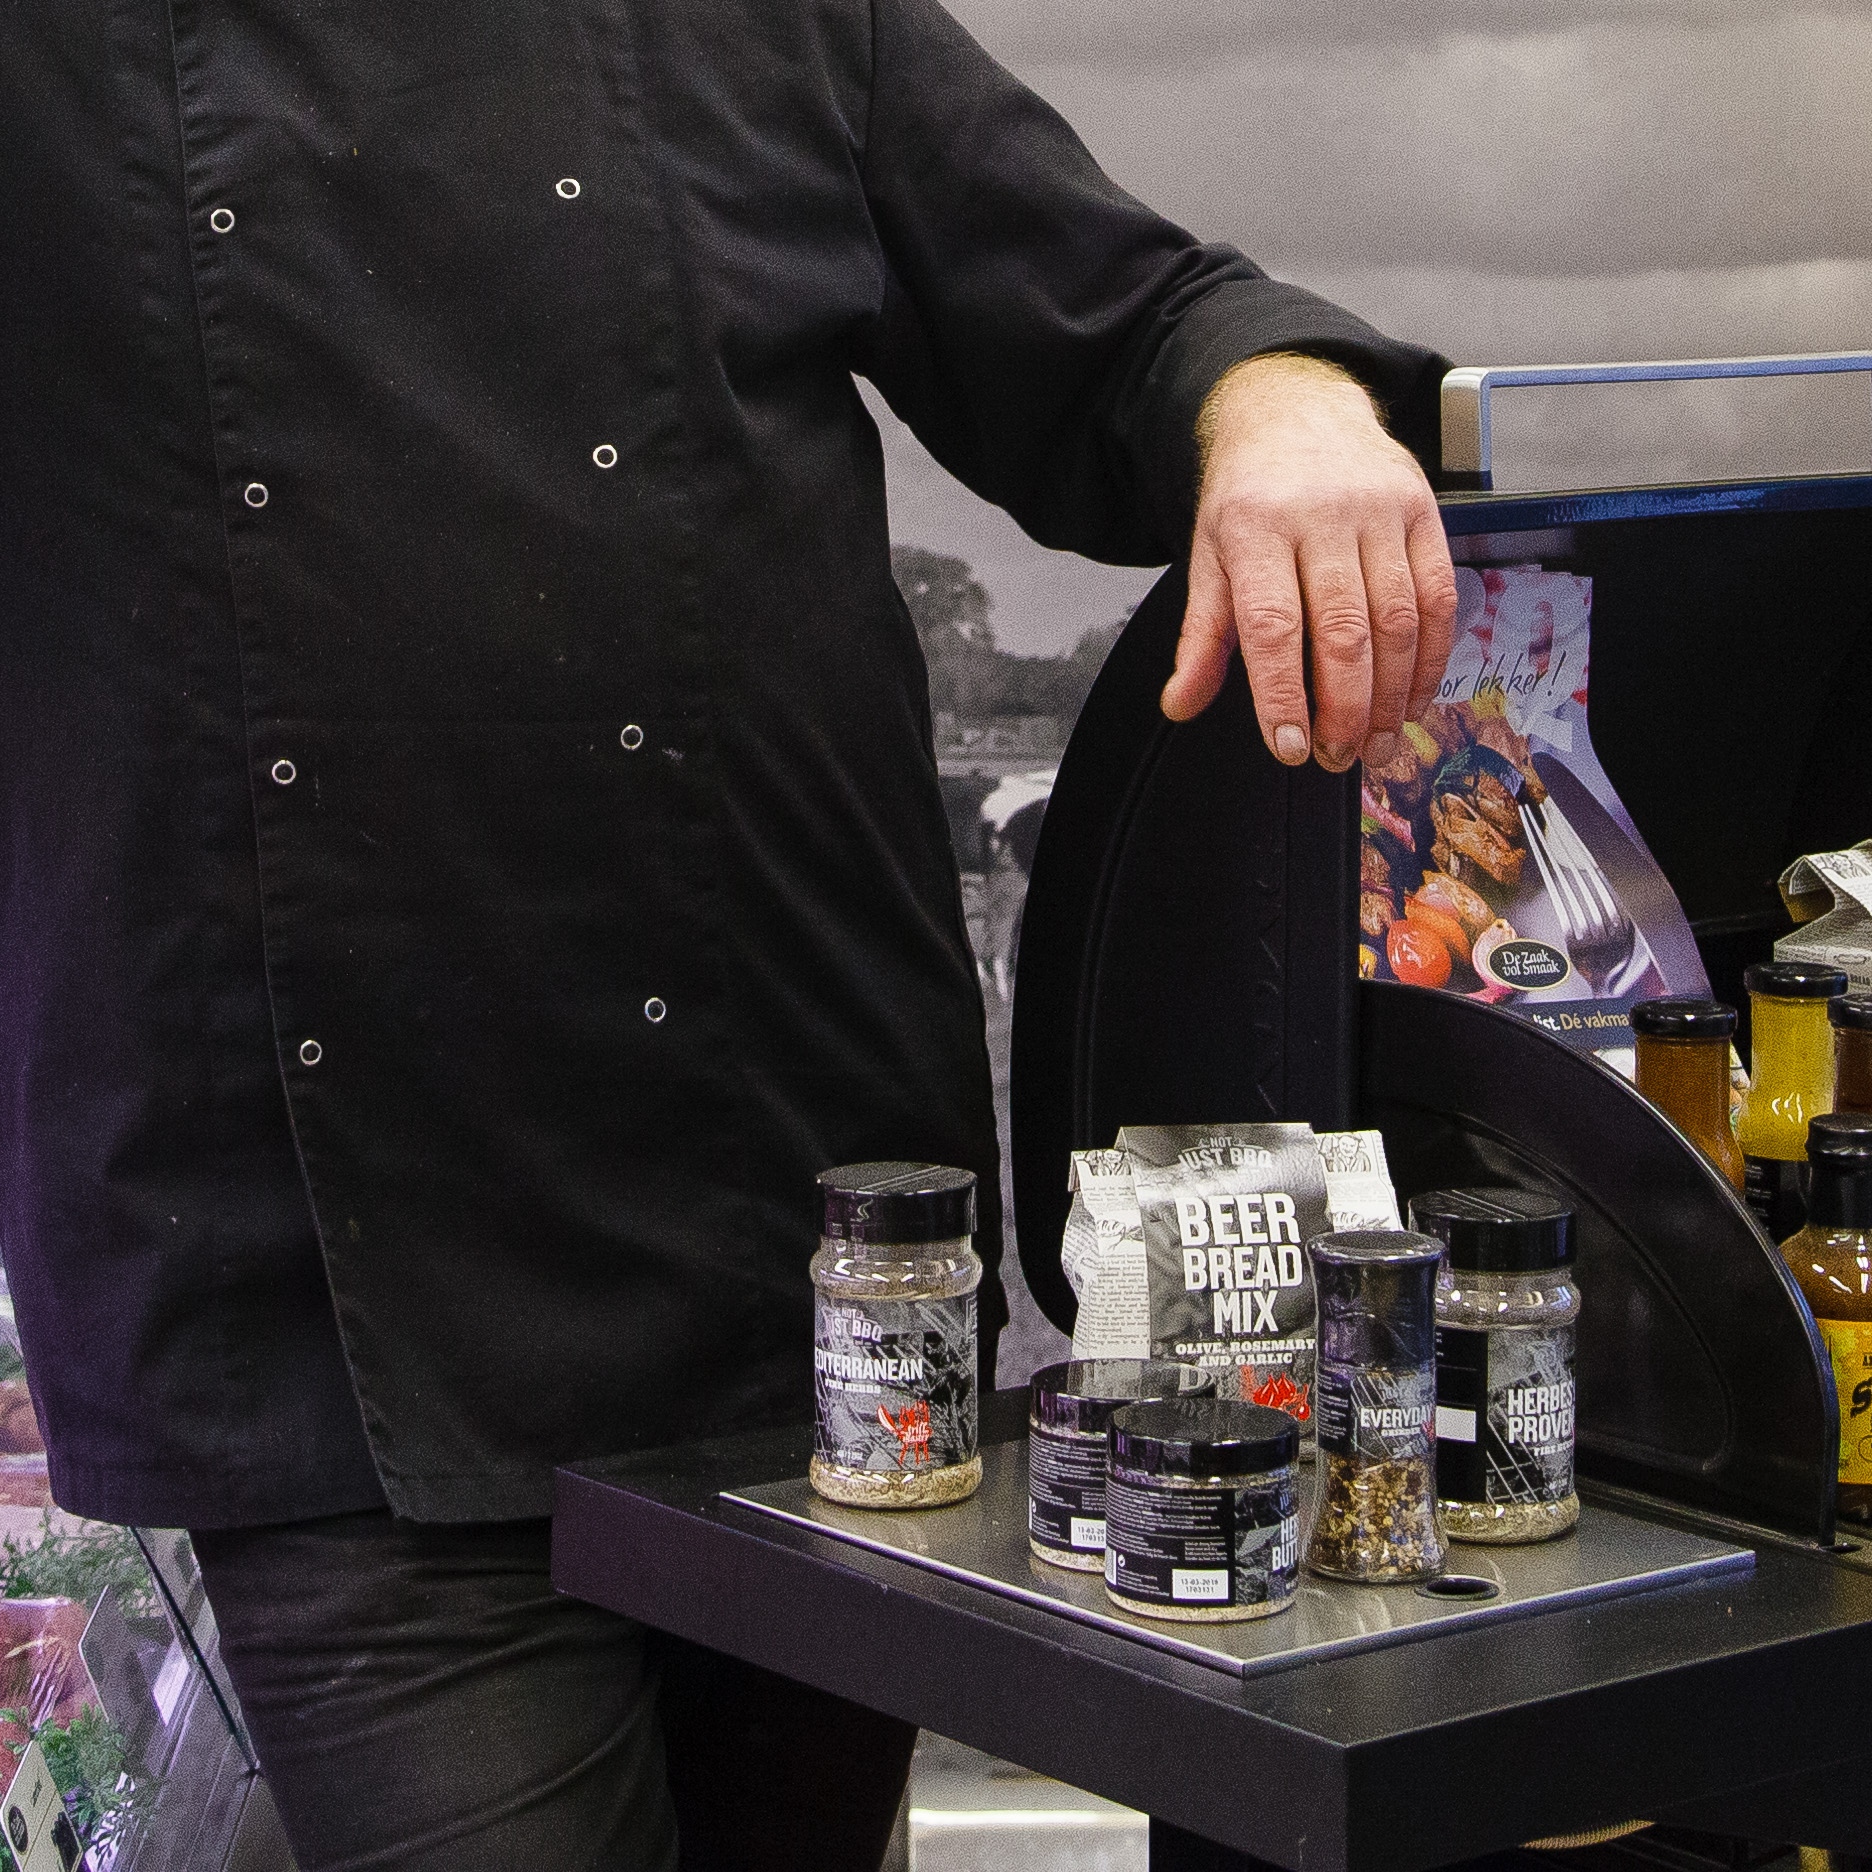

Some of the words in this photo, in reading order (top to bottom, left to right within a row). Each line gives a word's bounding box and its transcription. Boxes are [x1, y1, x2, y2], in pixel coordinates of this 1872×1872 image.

[1503, 950, 1521, 967] De
[1521, 946, 1550, 966] Zaak
[1503, 962, 1522, 977] vol
[1522, 960, 1561, 976] Smaak
[1583, 1009, 1630, 1029] vakma
[1178, 1149, 1225, 1170] JUST
[1231, 1149, 1273, 1169] BBQ
[1175, 1192, 1301, 1246] BEER
[1183, 1244, 1304, 1291] BREAD
[1213, 1290, 1279, 1335] MIX
[852, 1320, 884, 1343] BBQ
[1175, 1341, 1226, 1356] OLIVE,
[1228, 1338, 1316, 1354] ROSEMARY
[814, 1346, 924, 1382] EDITERRANEAN
[1199, 1354, 1232, 1367] AND
[1234, 1352, 1293, 1366] GARLIC
